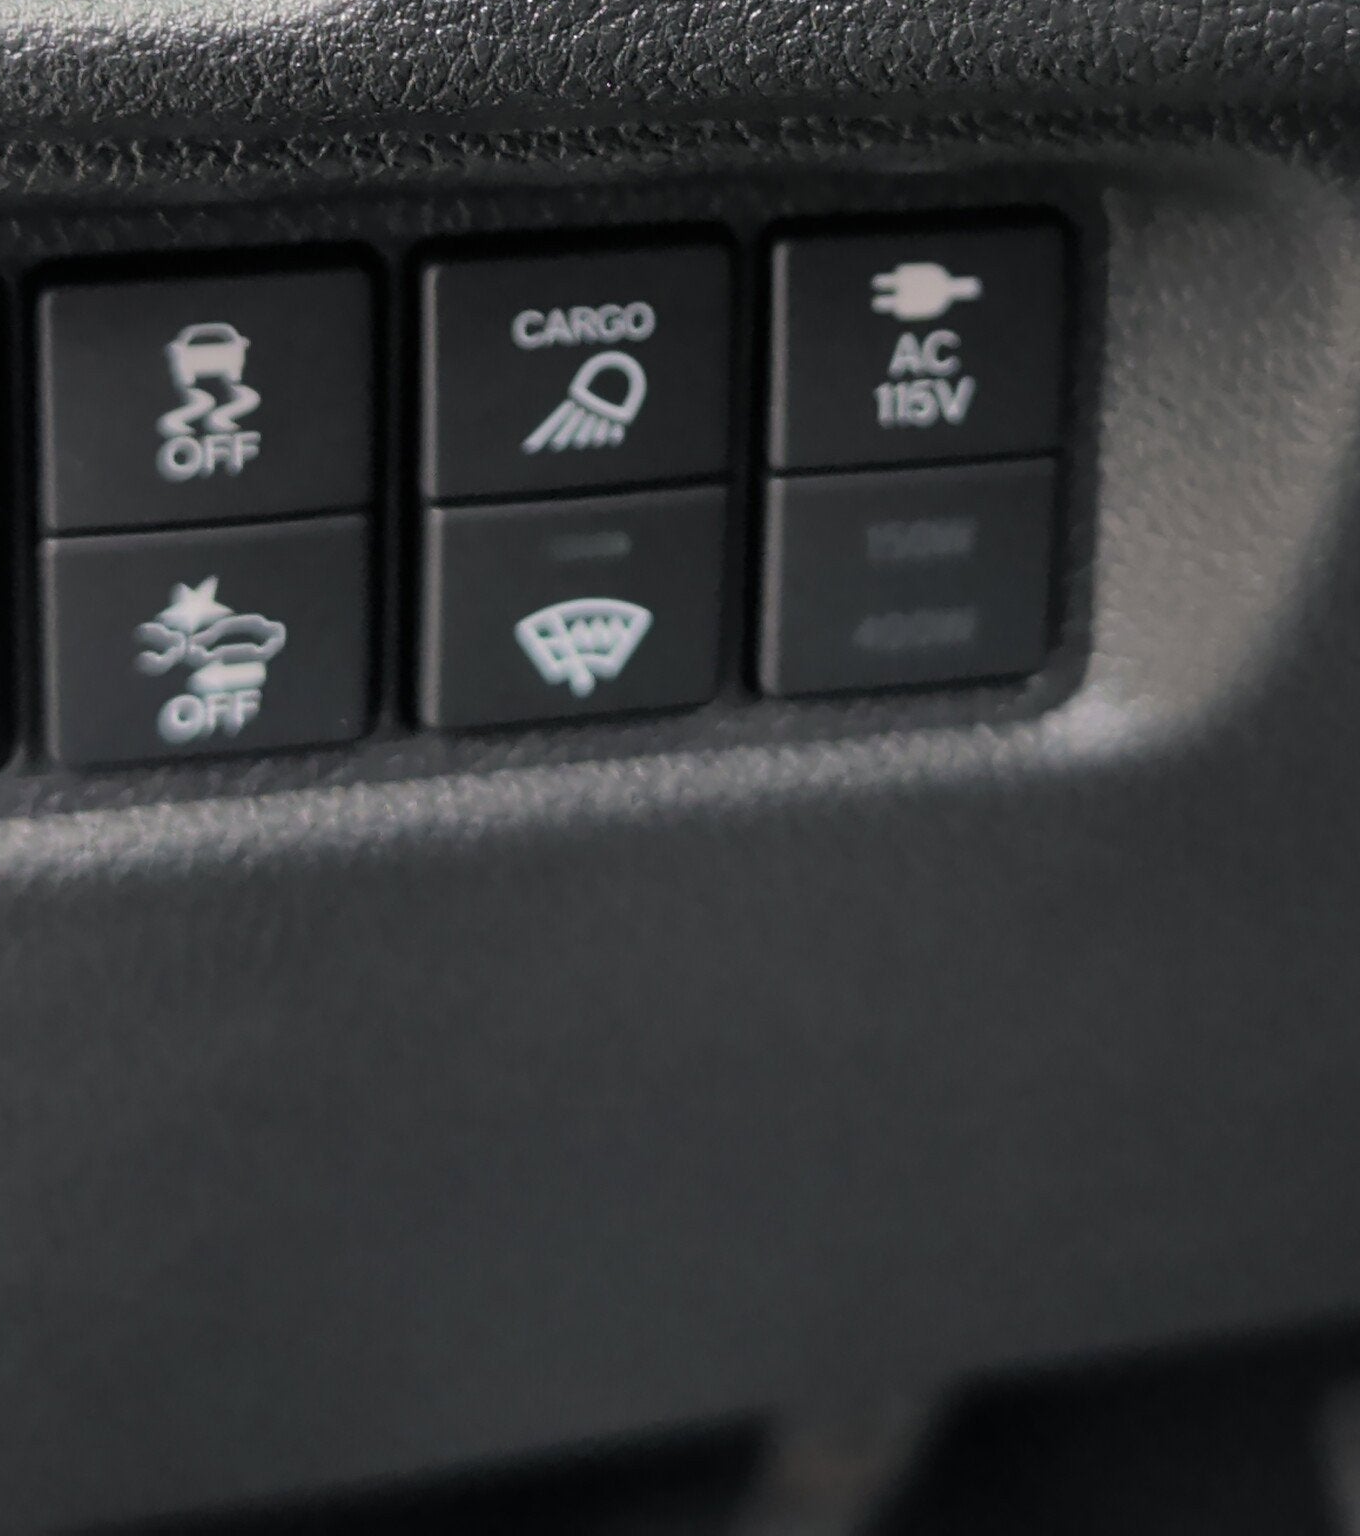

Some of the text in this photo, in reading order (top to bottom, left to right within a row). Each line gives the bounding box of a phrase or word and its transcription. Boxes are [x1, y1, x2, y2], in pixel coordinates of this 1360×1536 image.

[512, 301, 656, 349] CARGO
[889, 330, 960, 378] AC
[873, 378, 975, 427] 115V
[157, 431, 260, 481] OFF
[158, 692, 261, 742] OFF
